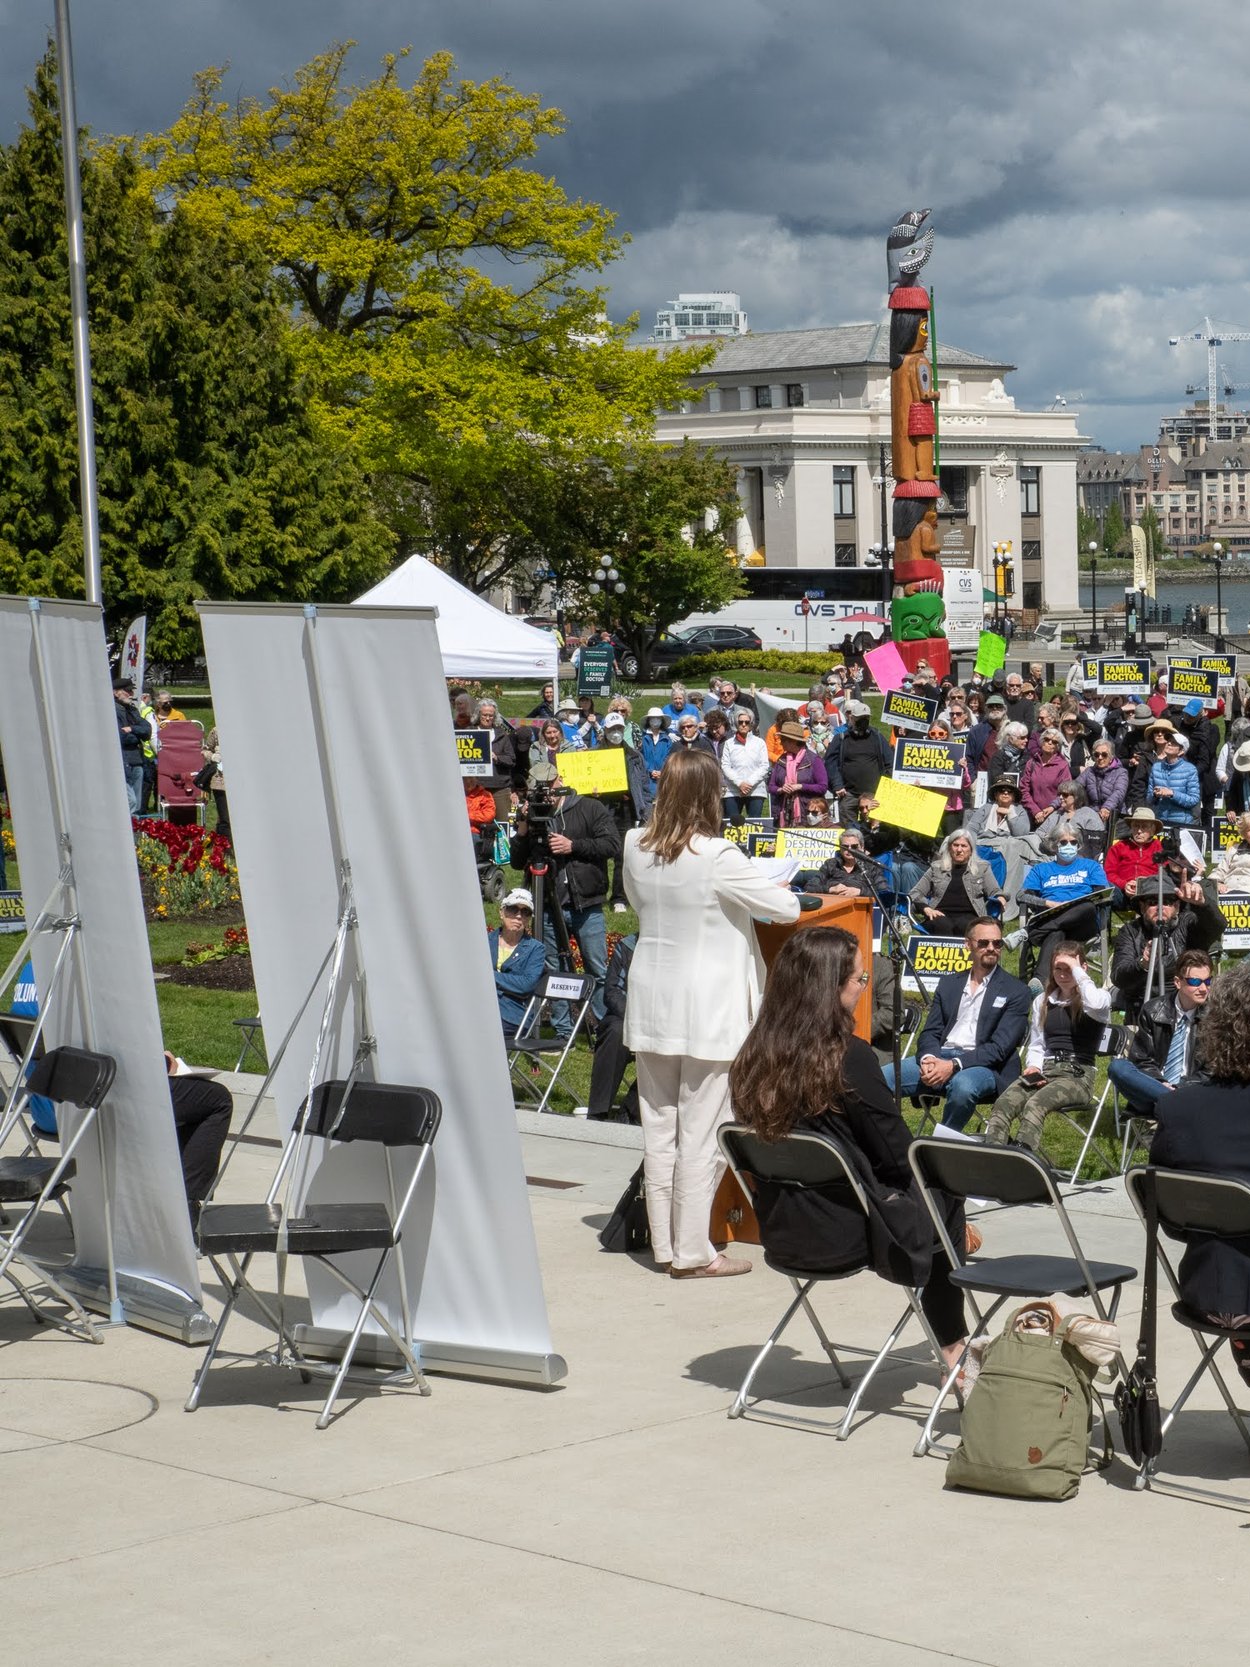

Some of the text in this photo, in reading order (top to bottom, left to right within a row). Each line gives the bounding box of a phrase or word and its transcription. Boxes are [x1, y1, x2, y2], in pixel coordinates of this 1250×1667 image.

[1133, 537, 1143, 584] STEAMSHIP
[959, 578, 972, 588] CVS
[1104, 665, 1138, 674] FAMILY
[1104, 673, 1144, 681] DOCTOR
[1174, 673, 1208, 685] FAMILY
[1174, 682, 1212, 694] DOCTOR
[891, 696, 926, 711] FAMILY
[890, 704, 928, 720] DOCTOR
[904, 746, 950, 760] FAMILY
[903, 756, 955, 770] DOCTOR
[587, 766, 592, 775] 5
[882, 780, 928, 801] EVERYONE
[784, 830, 837, 839] EVERYONE
[785, 840, 835, 849] DESERVES
[785, 849, 834, 858] A FAMILY
[802, 860, 821, 868] CTO
[1219, 905, 1250, 917] MILY
[916, 946, 971, 960] FAMILY
[14, 983, 38, 1002] OLUN
